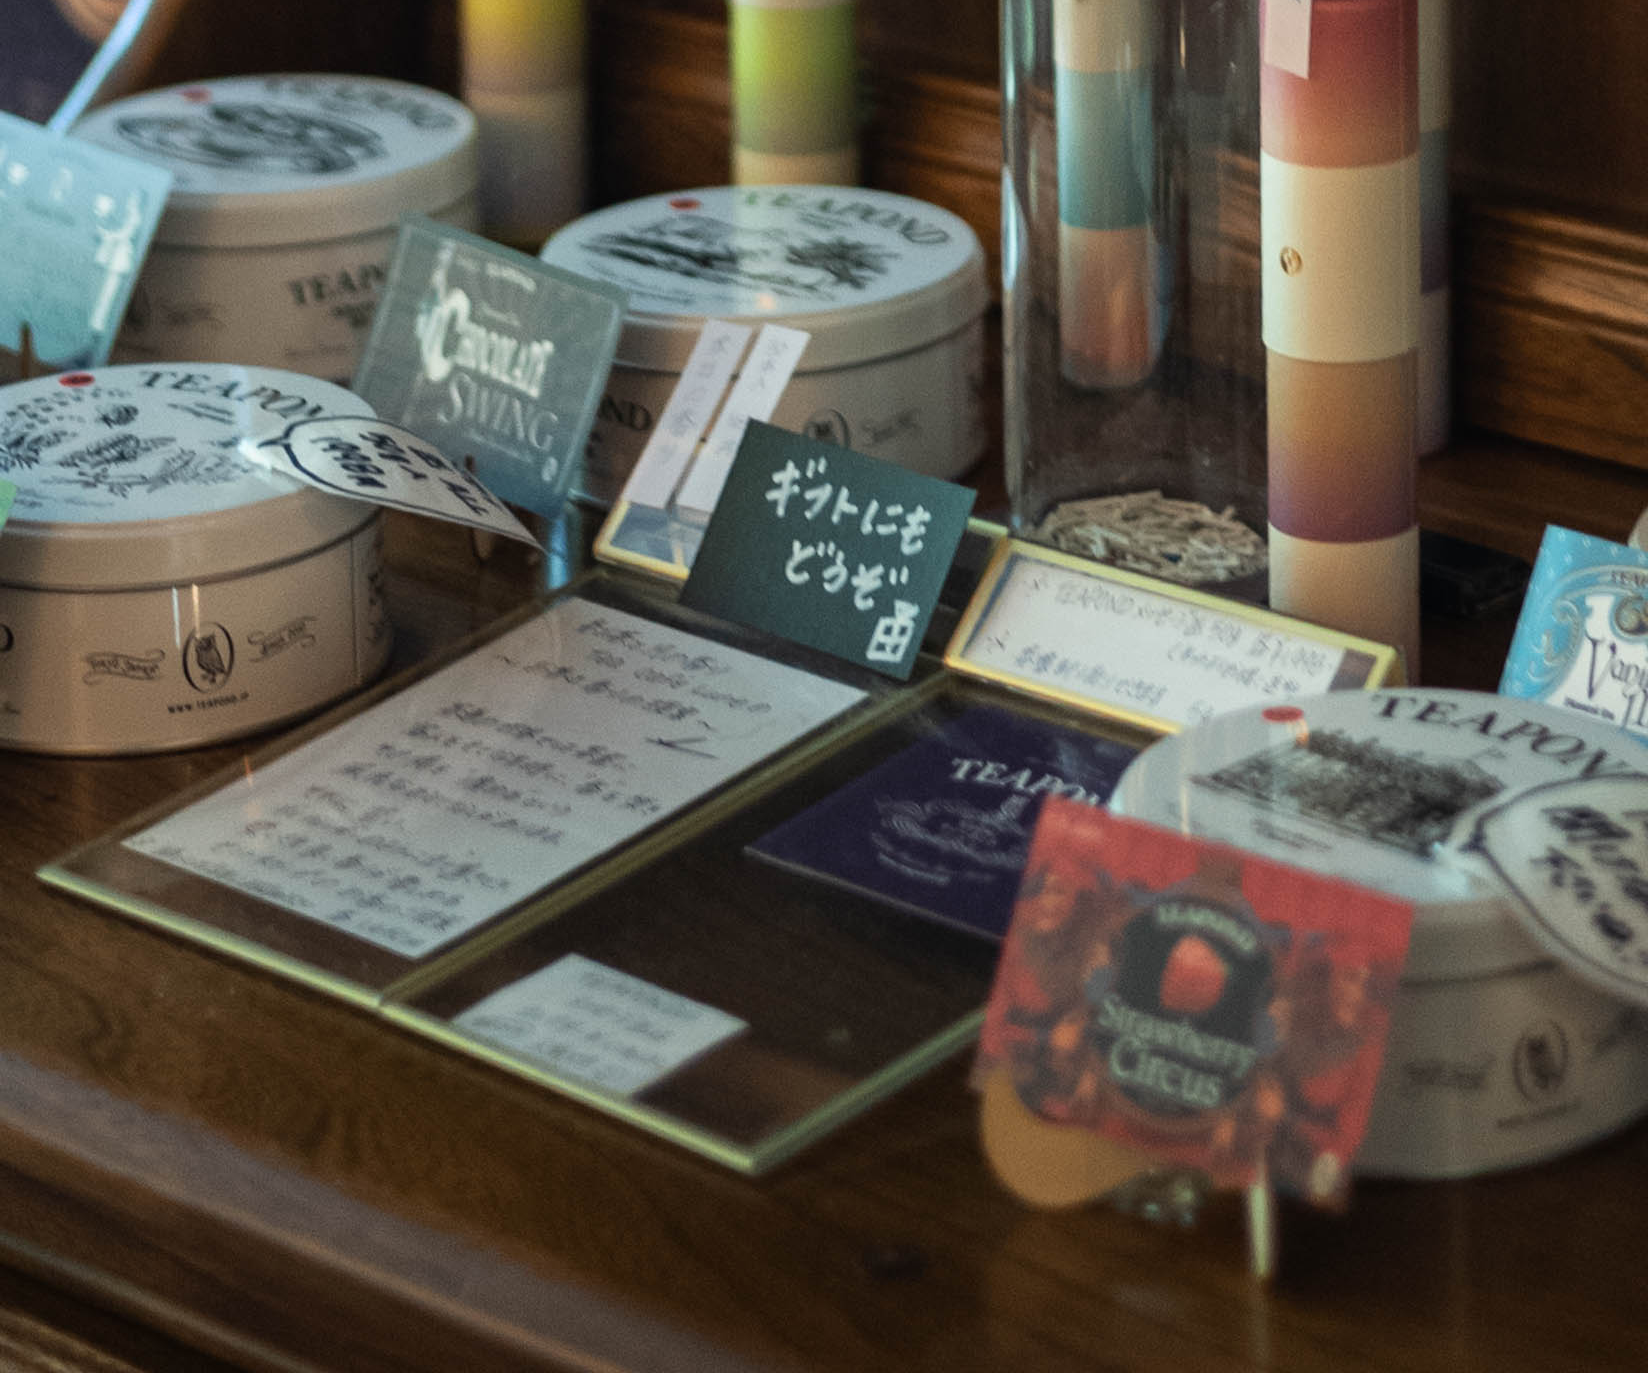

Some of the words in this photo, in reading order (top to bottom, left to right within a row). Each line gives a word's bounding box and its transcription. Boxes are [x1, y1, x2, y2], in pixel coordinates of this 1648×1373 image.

[764, 455, 932, 556] ギフトにも
[785, 539, 909, 611] どうぞ
[1107, 1035, 1224, 1111] Circus
